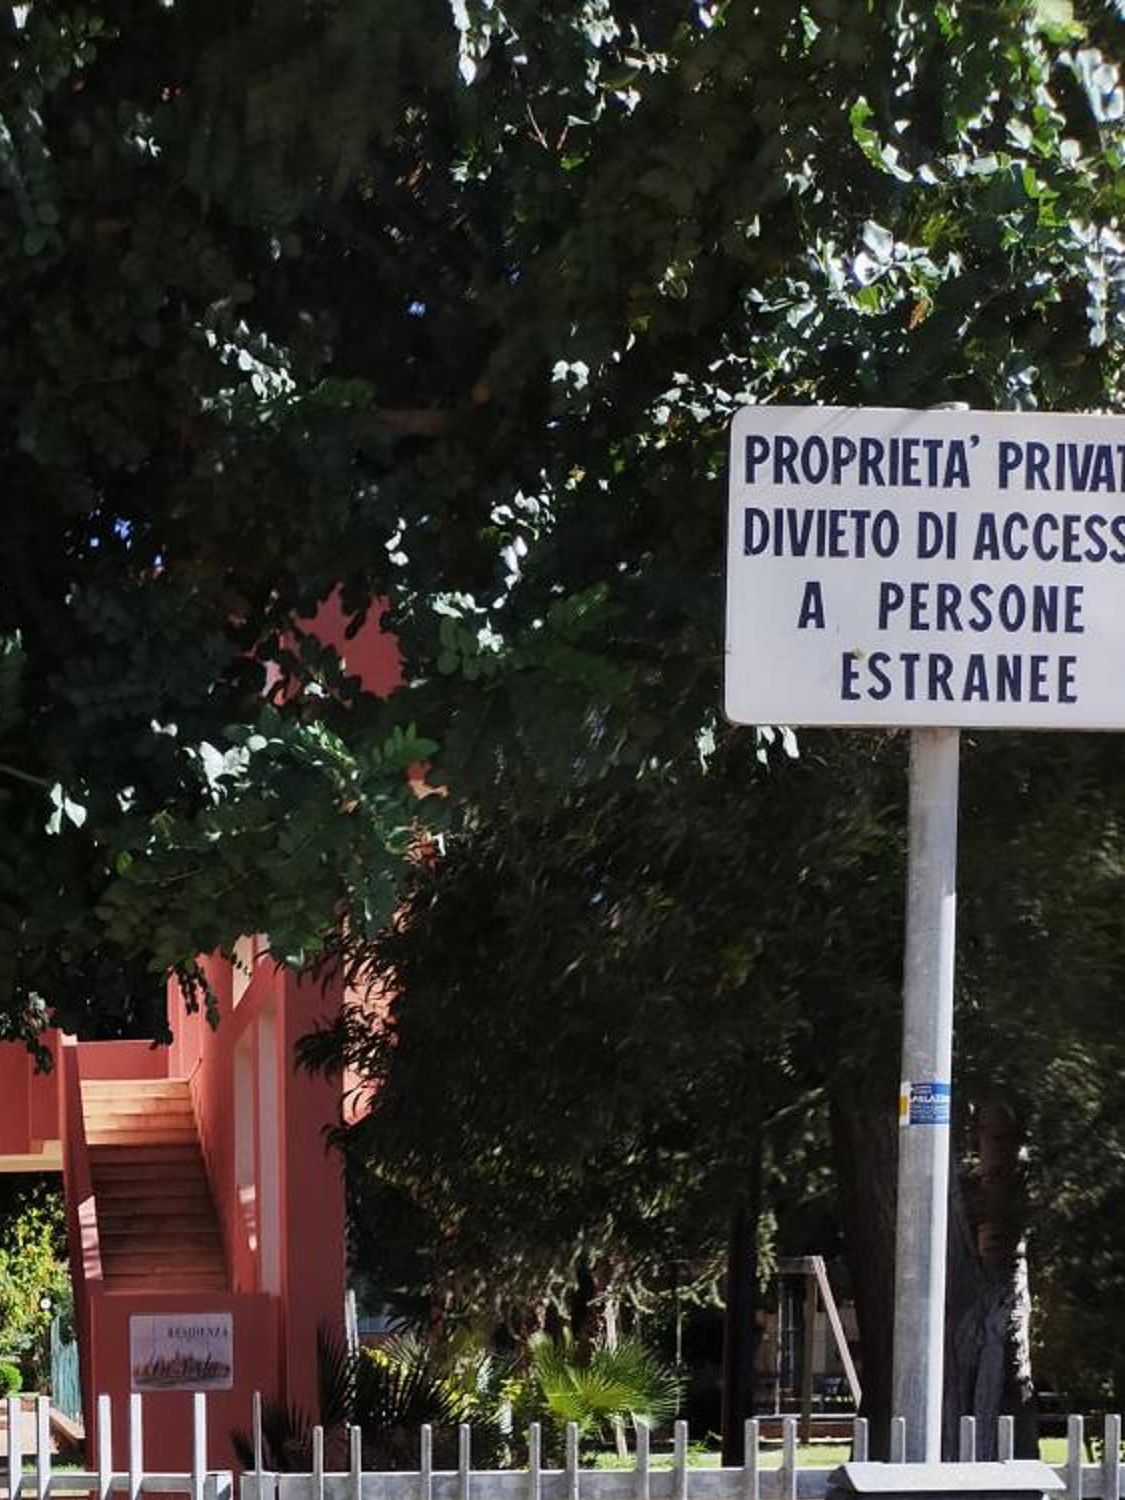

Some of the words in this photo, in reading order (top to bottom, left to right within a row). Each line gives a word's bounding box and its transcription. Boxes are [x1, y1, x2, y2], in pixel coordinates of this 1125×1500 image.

[744, 434, 980, 488] PROPRIETA'
[743, 507, 900, 559] DIVIETO
[917, 511, 957, 560] DI
[797, 581, 826, 630] A
[878, 581, 1085, 633] PERSONE
[840, 651, 1078, 703] ESTRANEE
